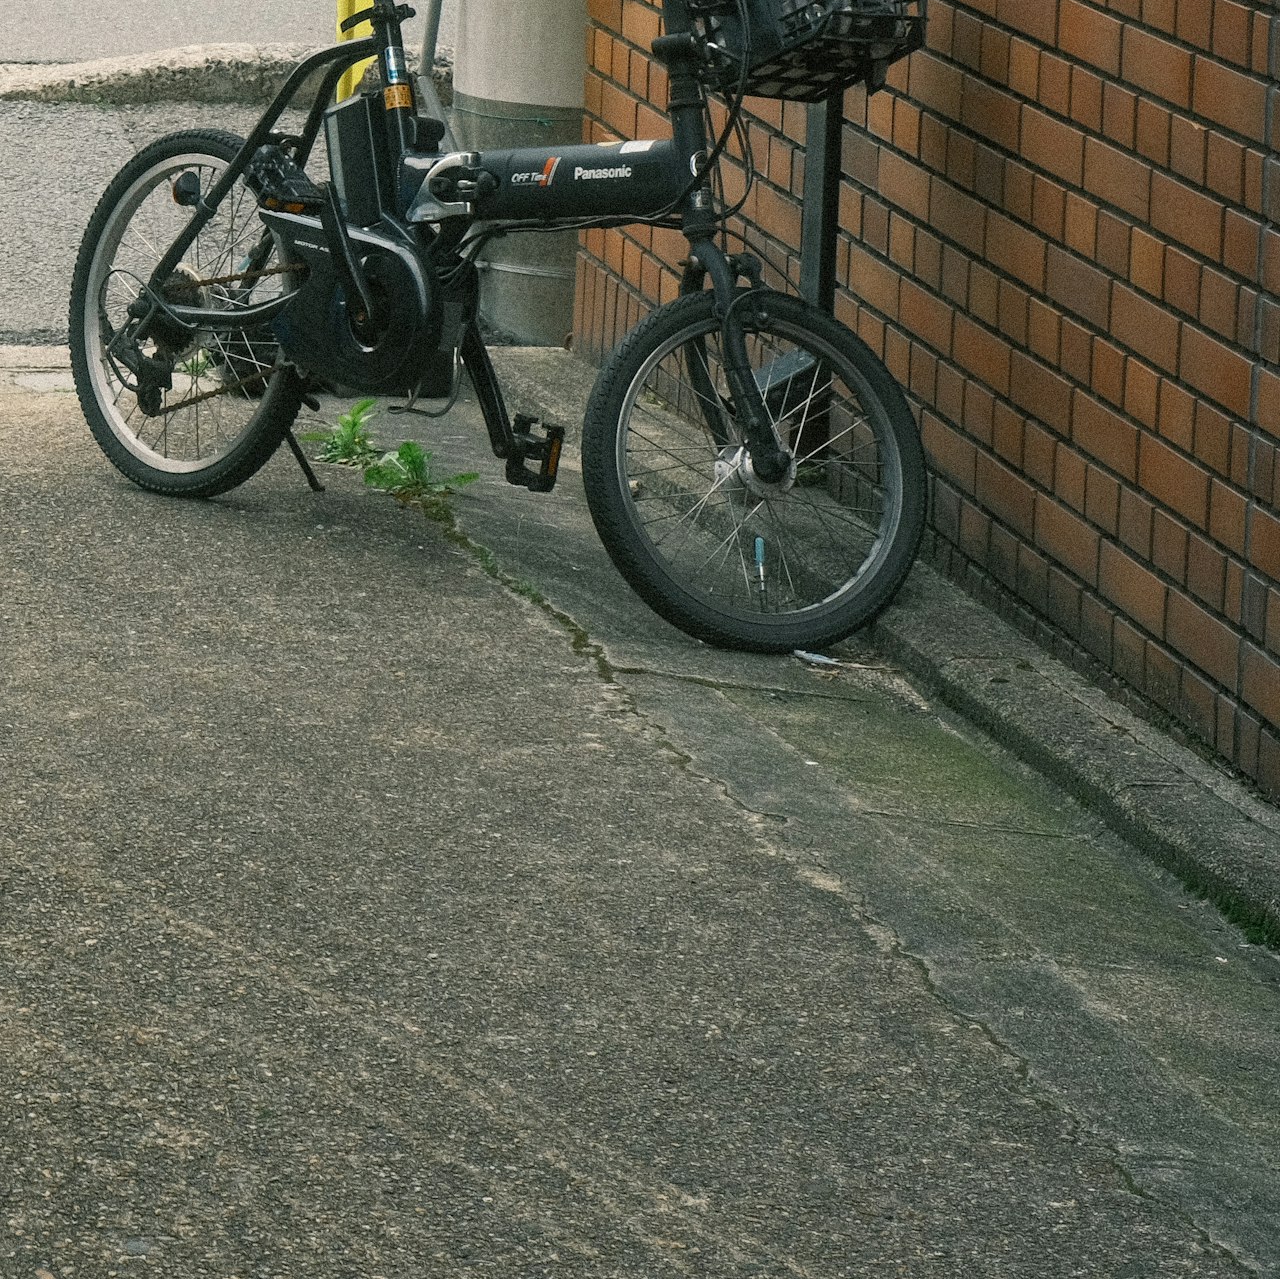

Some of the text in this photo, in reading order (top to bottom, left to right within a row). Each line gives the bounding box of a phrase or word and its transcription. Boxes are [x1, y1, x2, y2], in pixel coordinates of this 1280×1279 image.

[511, 173, 530, 182] OFF
[574, 165, 632, 180] Panasonic
[294, 239, 318, 249] MOTOR
